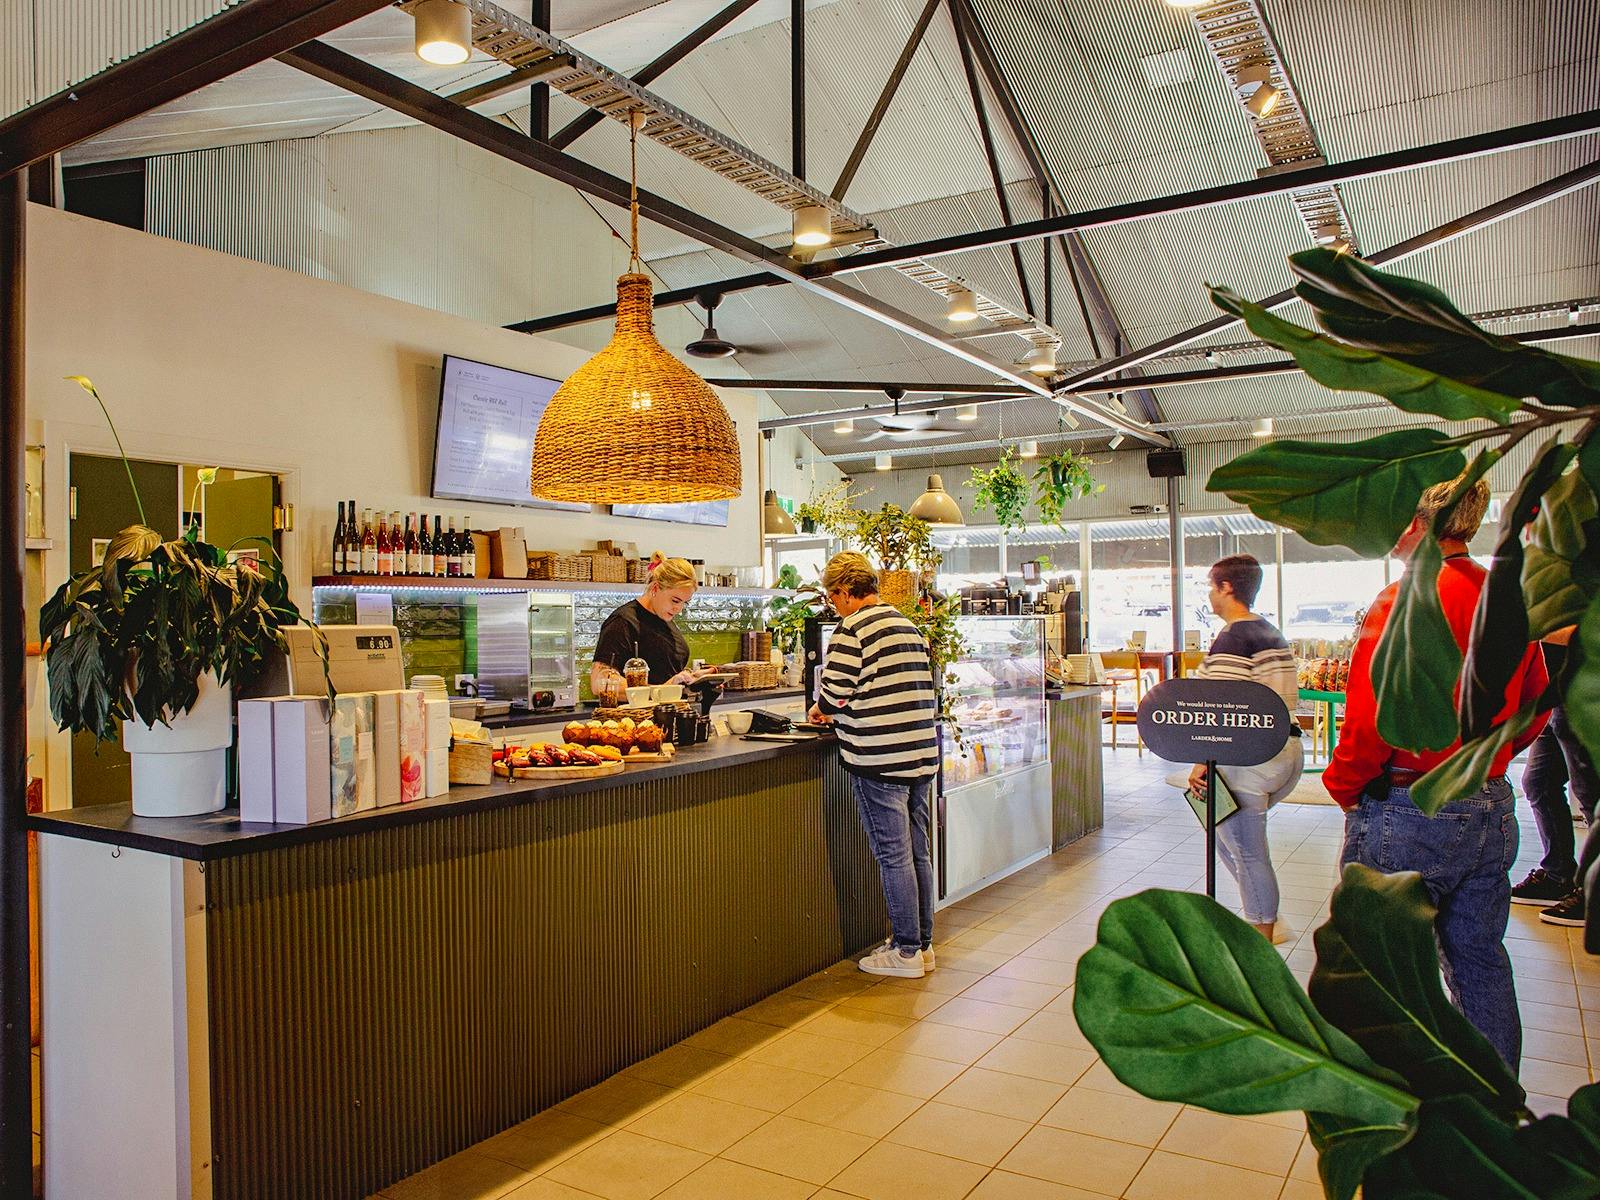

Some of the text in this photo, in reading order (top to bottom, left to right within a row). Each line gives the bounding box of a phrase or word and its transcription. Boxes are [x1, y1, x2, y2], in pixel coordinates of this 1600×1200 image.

[370, 640, 389, 649] 6.90
[1152, 710, 1275, 729] ORDER HERE
